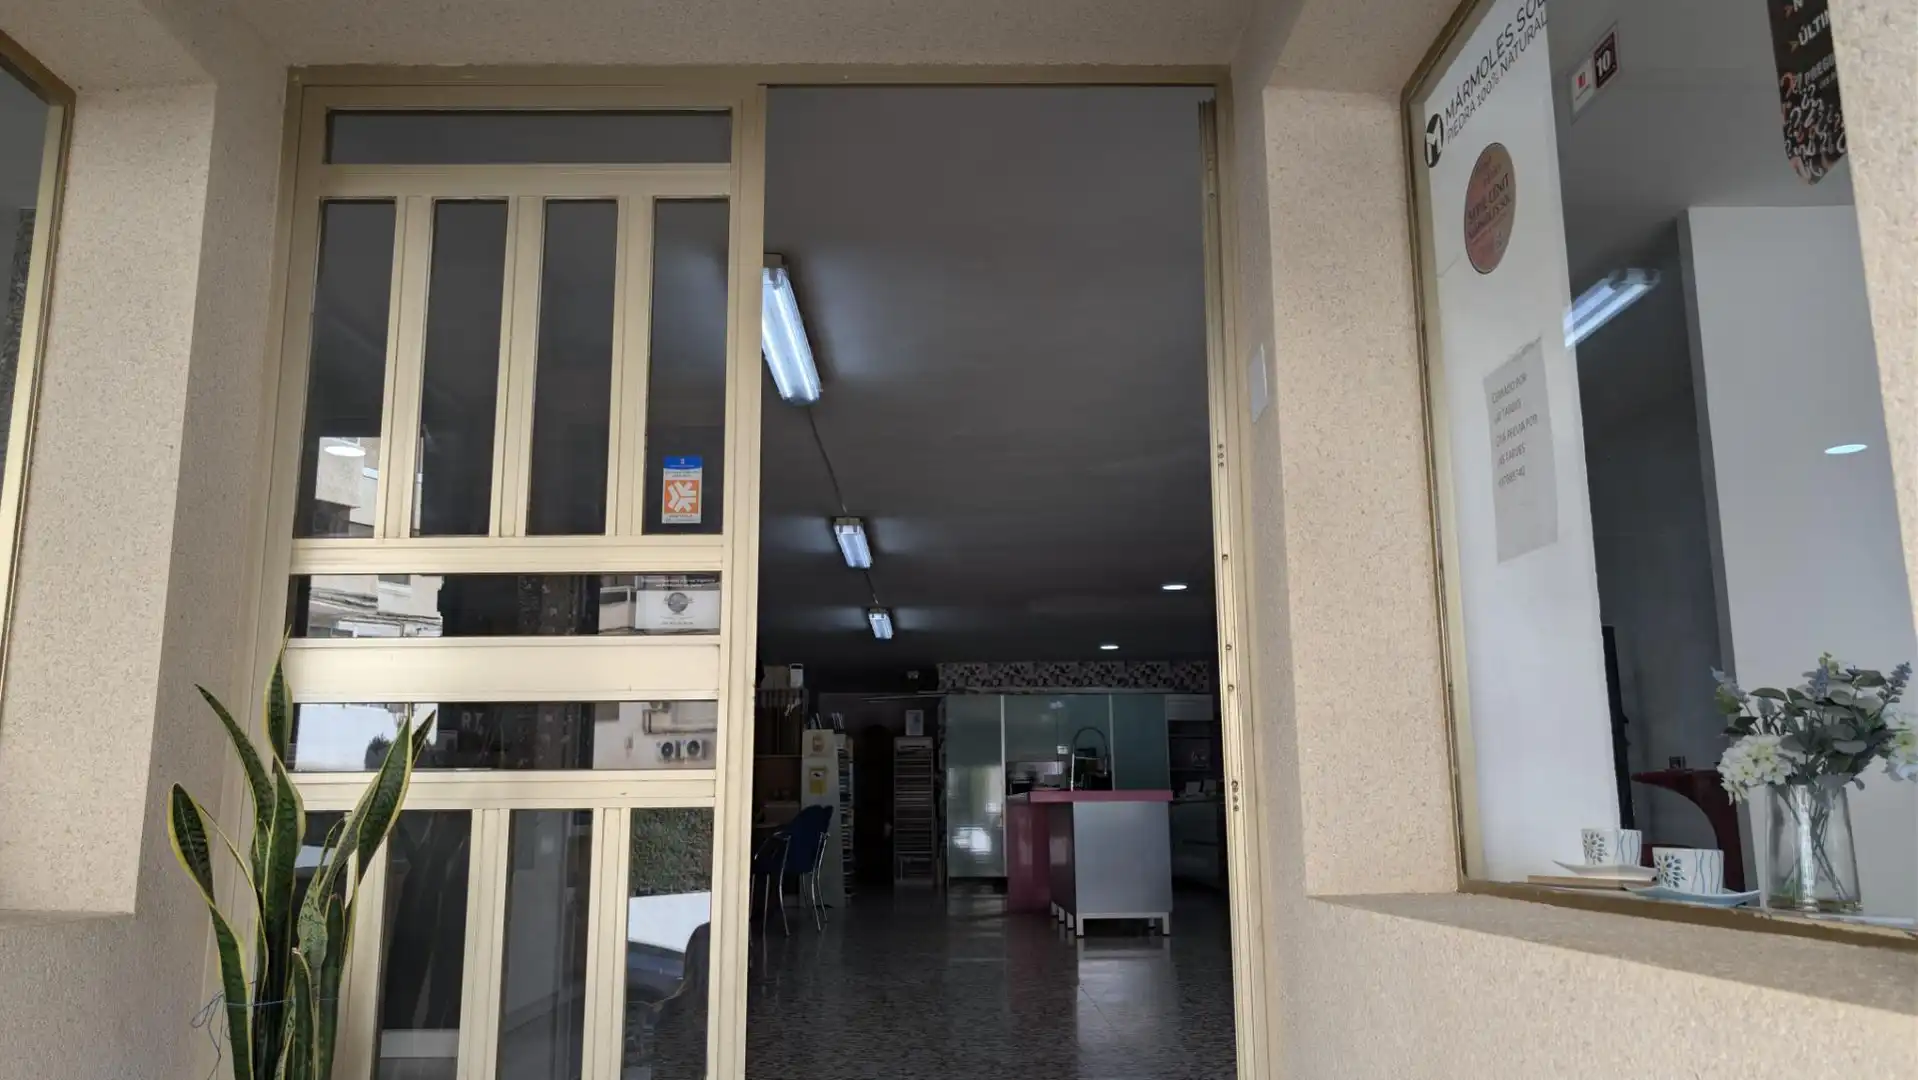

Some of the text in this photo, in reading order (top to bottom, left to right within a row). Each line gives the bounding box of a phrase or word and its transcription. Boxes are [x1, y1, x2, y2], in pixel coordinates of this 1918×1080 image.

[1446, 23, 1514, 126] MÁRMOLES
[1447, 99, 1477, 144] PIEDRA
[1500, 11, 1549, 77] NATURAL
